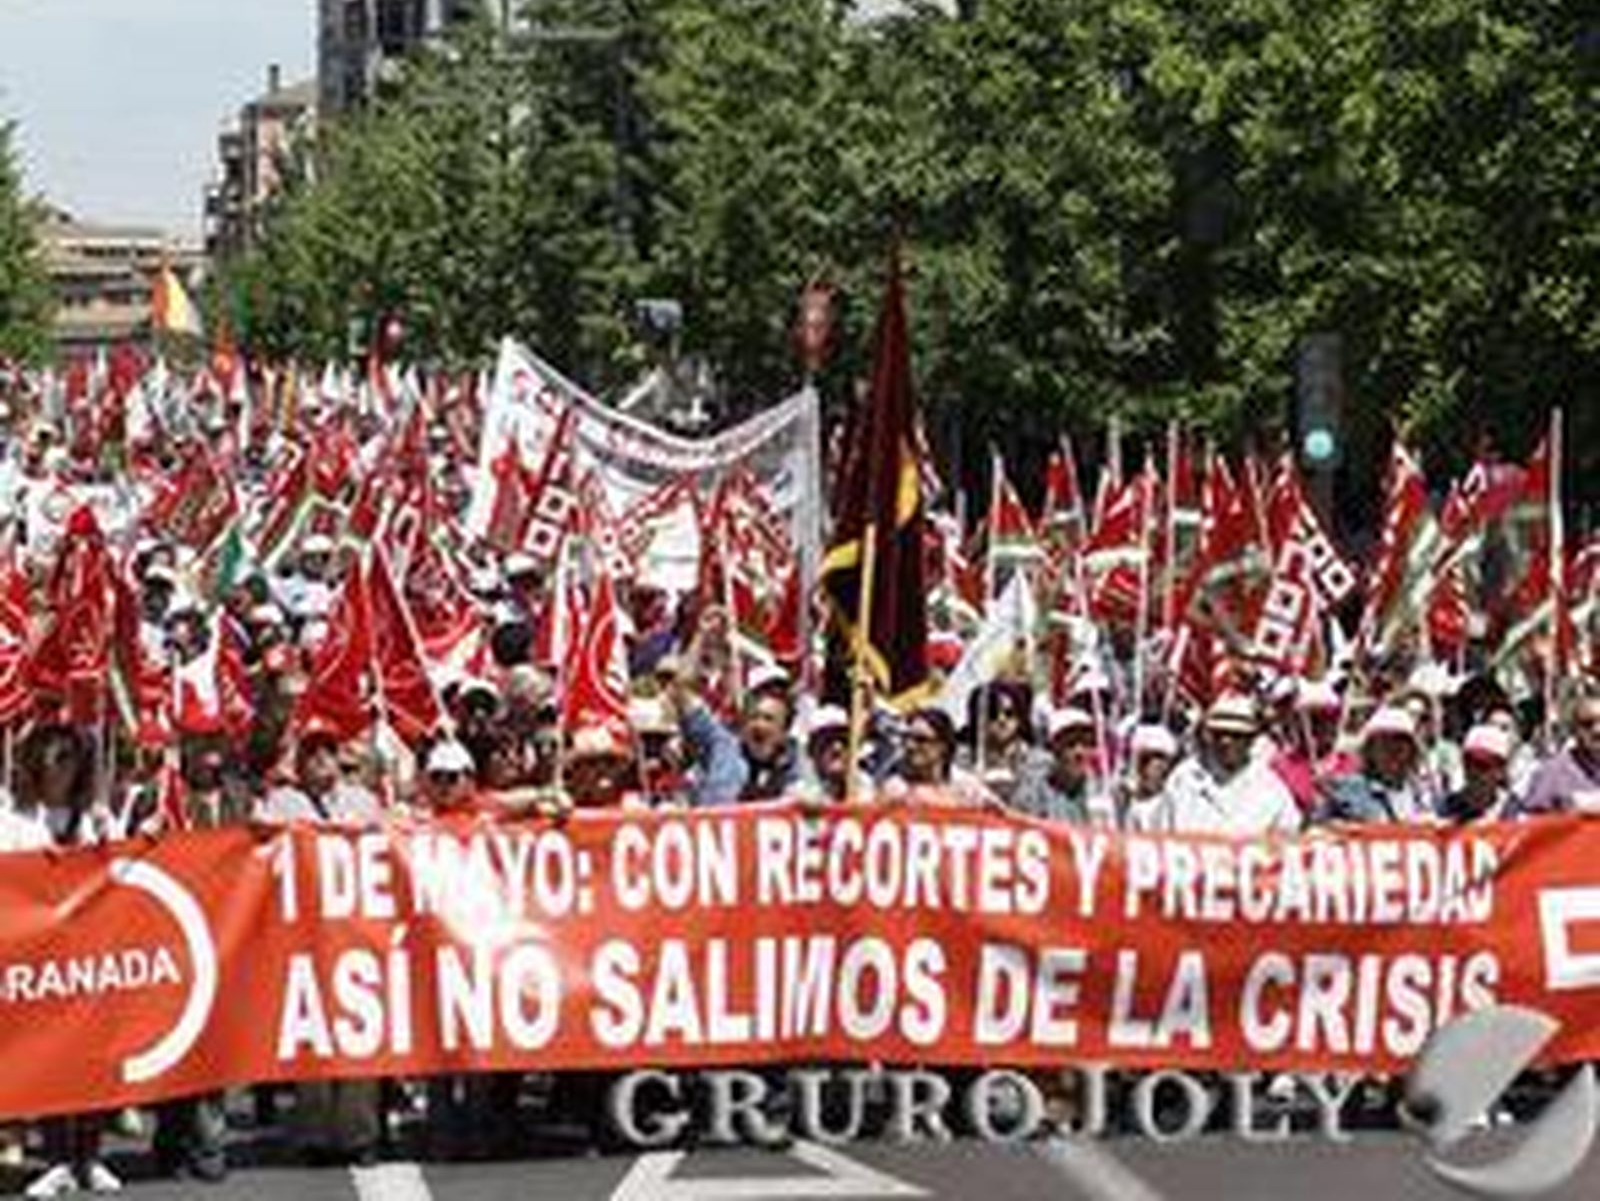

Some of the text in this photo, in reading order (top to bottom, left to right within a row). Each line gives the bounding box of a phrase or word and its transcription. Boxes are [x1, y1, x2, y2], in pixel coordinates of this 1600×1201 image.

[271, 832, 298, 923] 1
[316, 833, 397, 919] DE
[409, 828, 594, 918] MAYO:
[611, 819, 739, 910] CON
[756, 816, 1050, 914] RECORTES
[1070, 831, 1109, 917] Y
[0, 945, 183, 1002] RANADA
[276, 924, 412, 1061] ASÍ
[436, 940, 561, 1051] NO
[588, 933, 948, 1048] SALIMOS
[974, 941, 1088, 1047] DE
[1107, 948, 1212, 1049] LA
